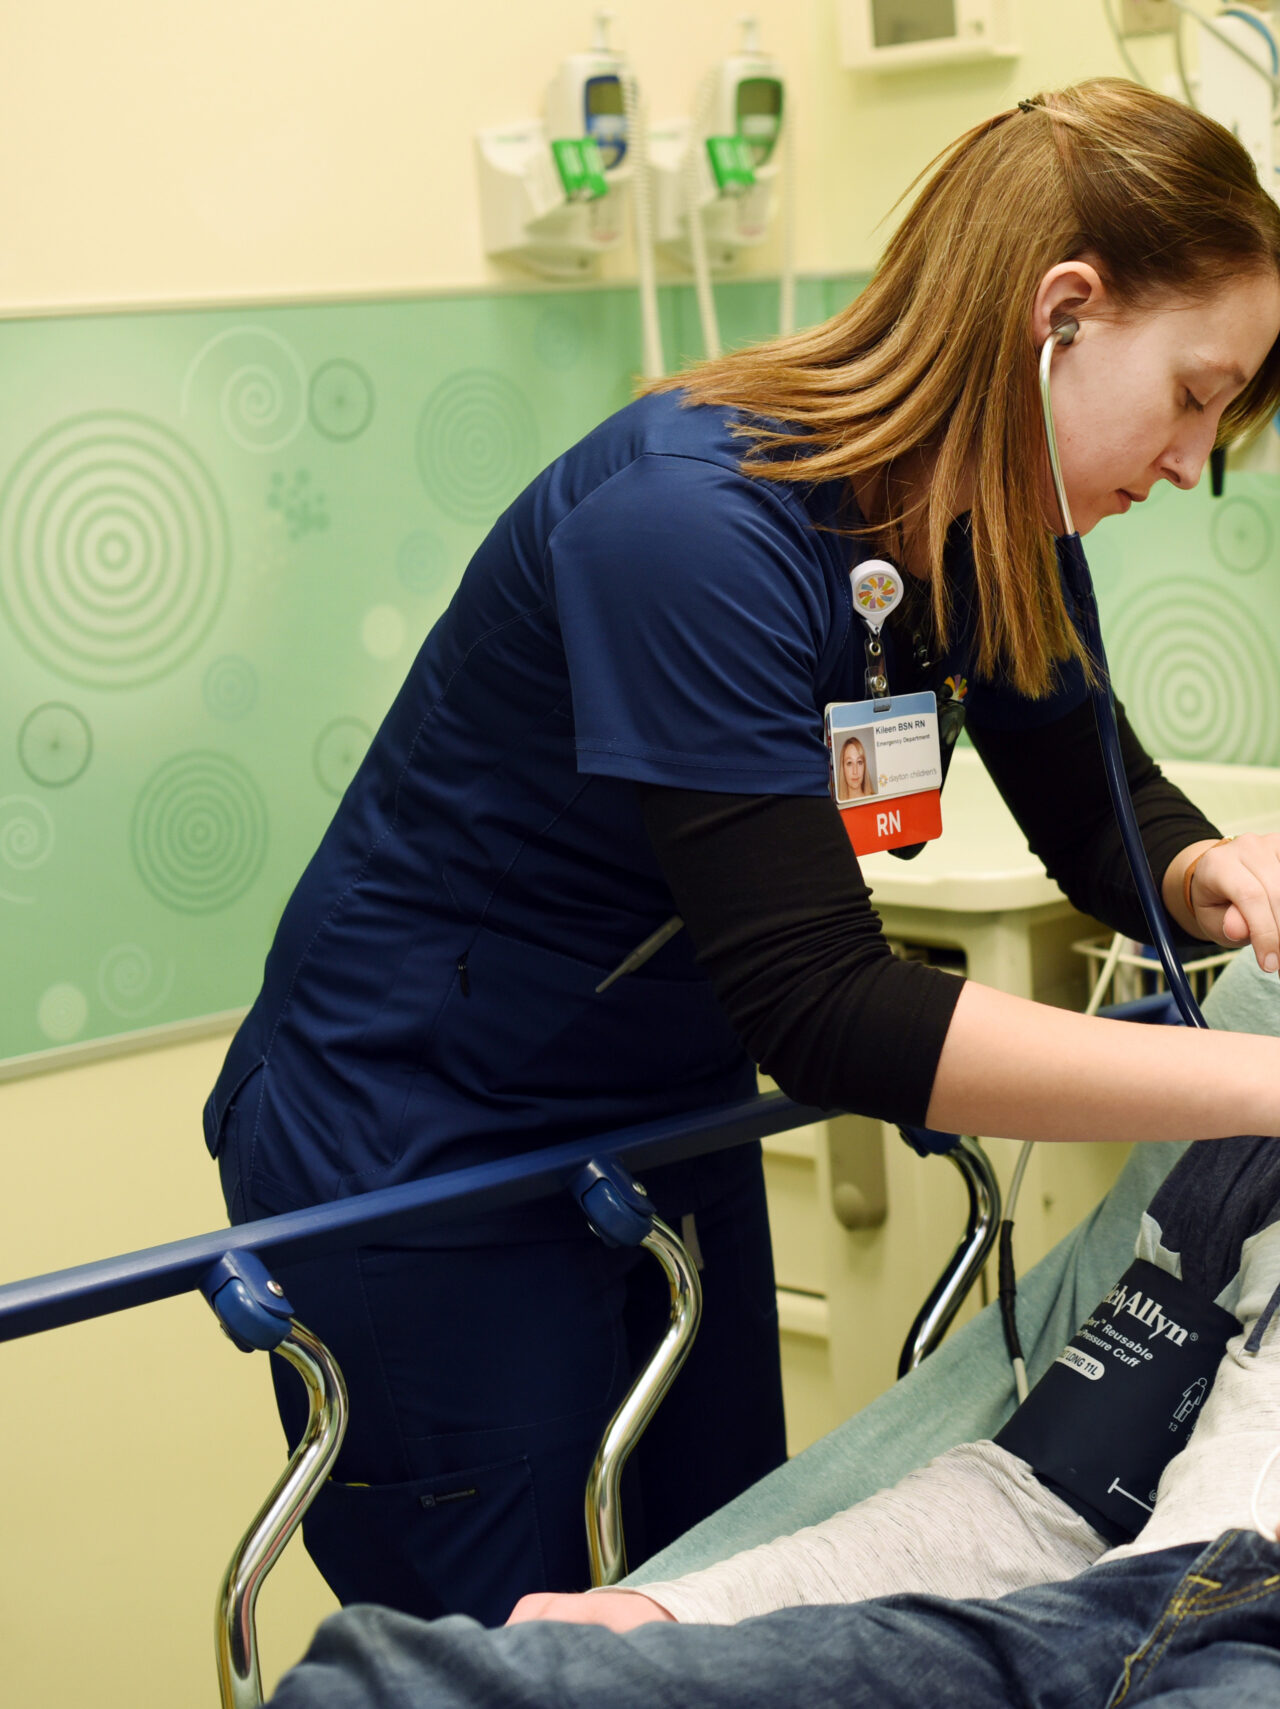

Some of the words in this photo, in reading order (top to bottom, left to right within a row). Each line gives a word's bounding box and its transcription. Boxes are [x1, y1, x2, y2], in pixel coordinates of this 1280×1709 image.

[876, 725, 897, 735] Kileen
[898, 721, 914, 732] BSN
[915, 719, 926, 728] RN
[903, 734, 930, 742] Department
[876, 809, 902, 838] RN
[1102, 1323, 1154, 1361] Reusable
[1065, 1352, 1086, 1368] LONG
[1084, 1362, 1099, 1376] 11L
[1112, 1347, 1141, 1367] Cuff
[1168, 1422, 1178, 1432] 13
